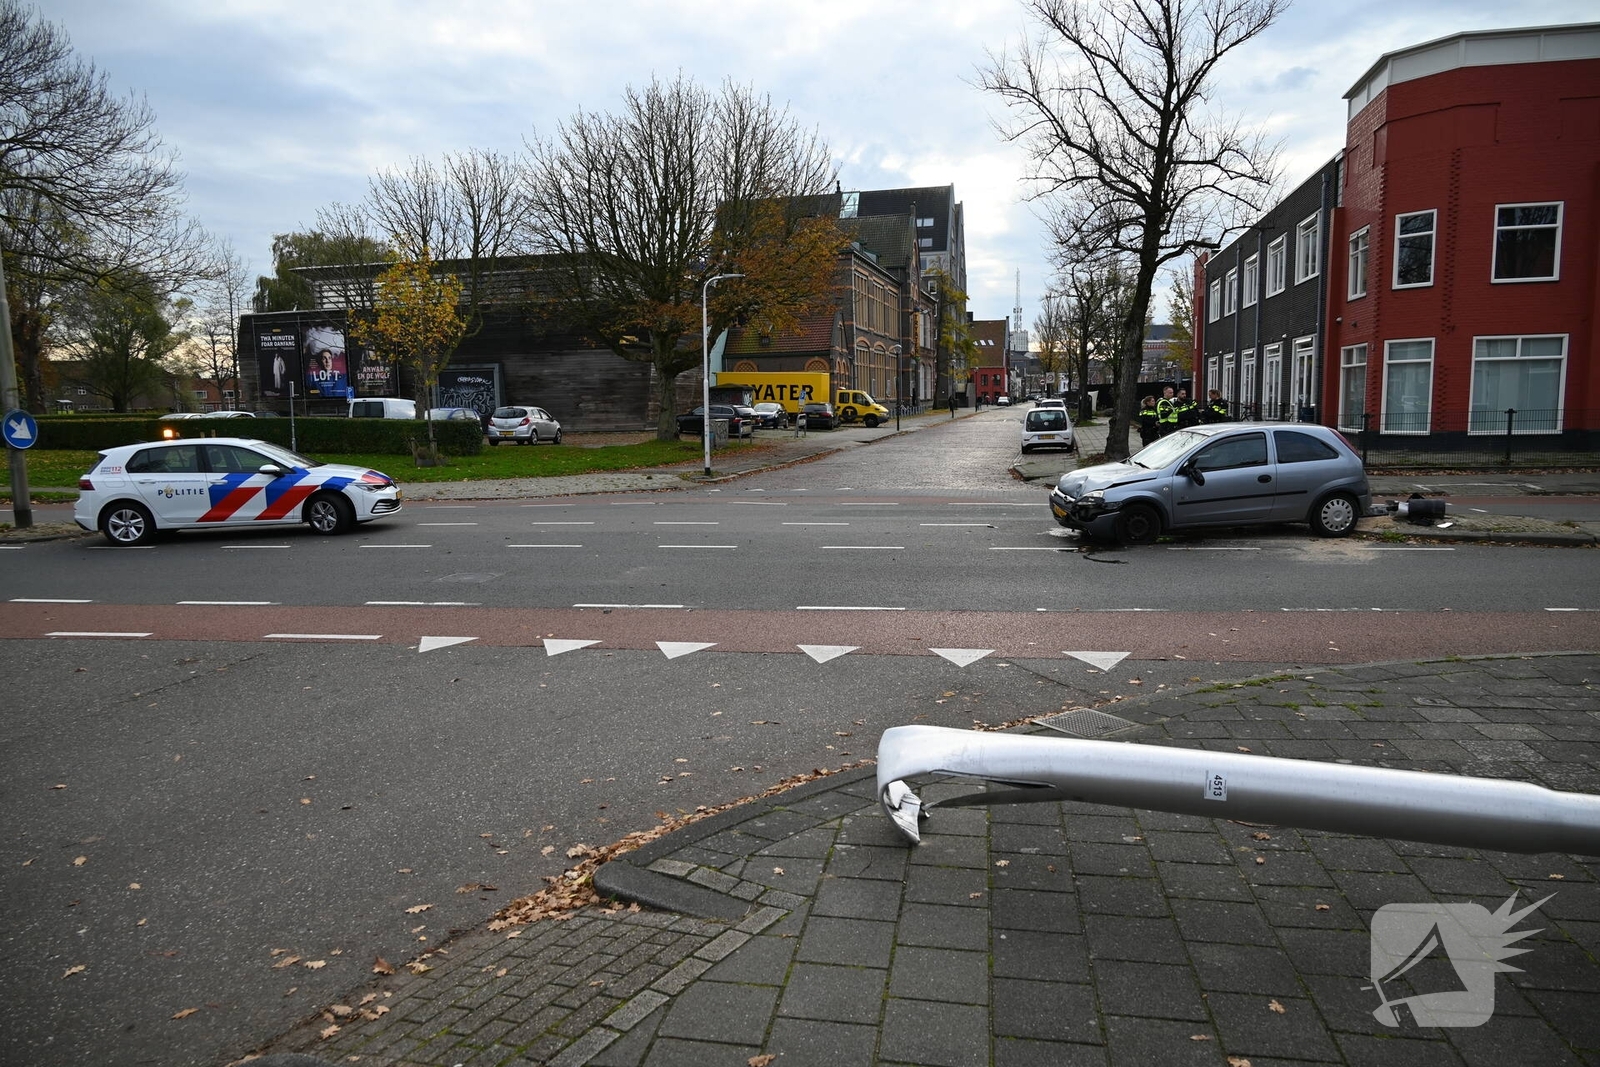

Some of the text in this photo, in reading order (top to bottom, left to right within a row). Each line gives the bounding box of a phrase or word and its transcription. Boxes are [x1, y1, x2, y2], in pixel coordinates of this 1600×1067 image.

[313, 370, 340, 381] LOFT
[157, 485, 204, 499] POLITIE
[1213, 774, 1223, 796] 4513
